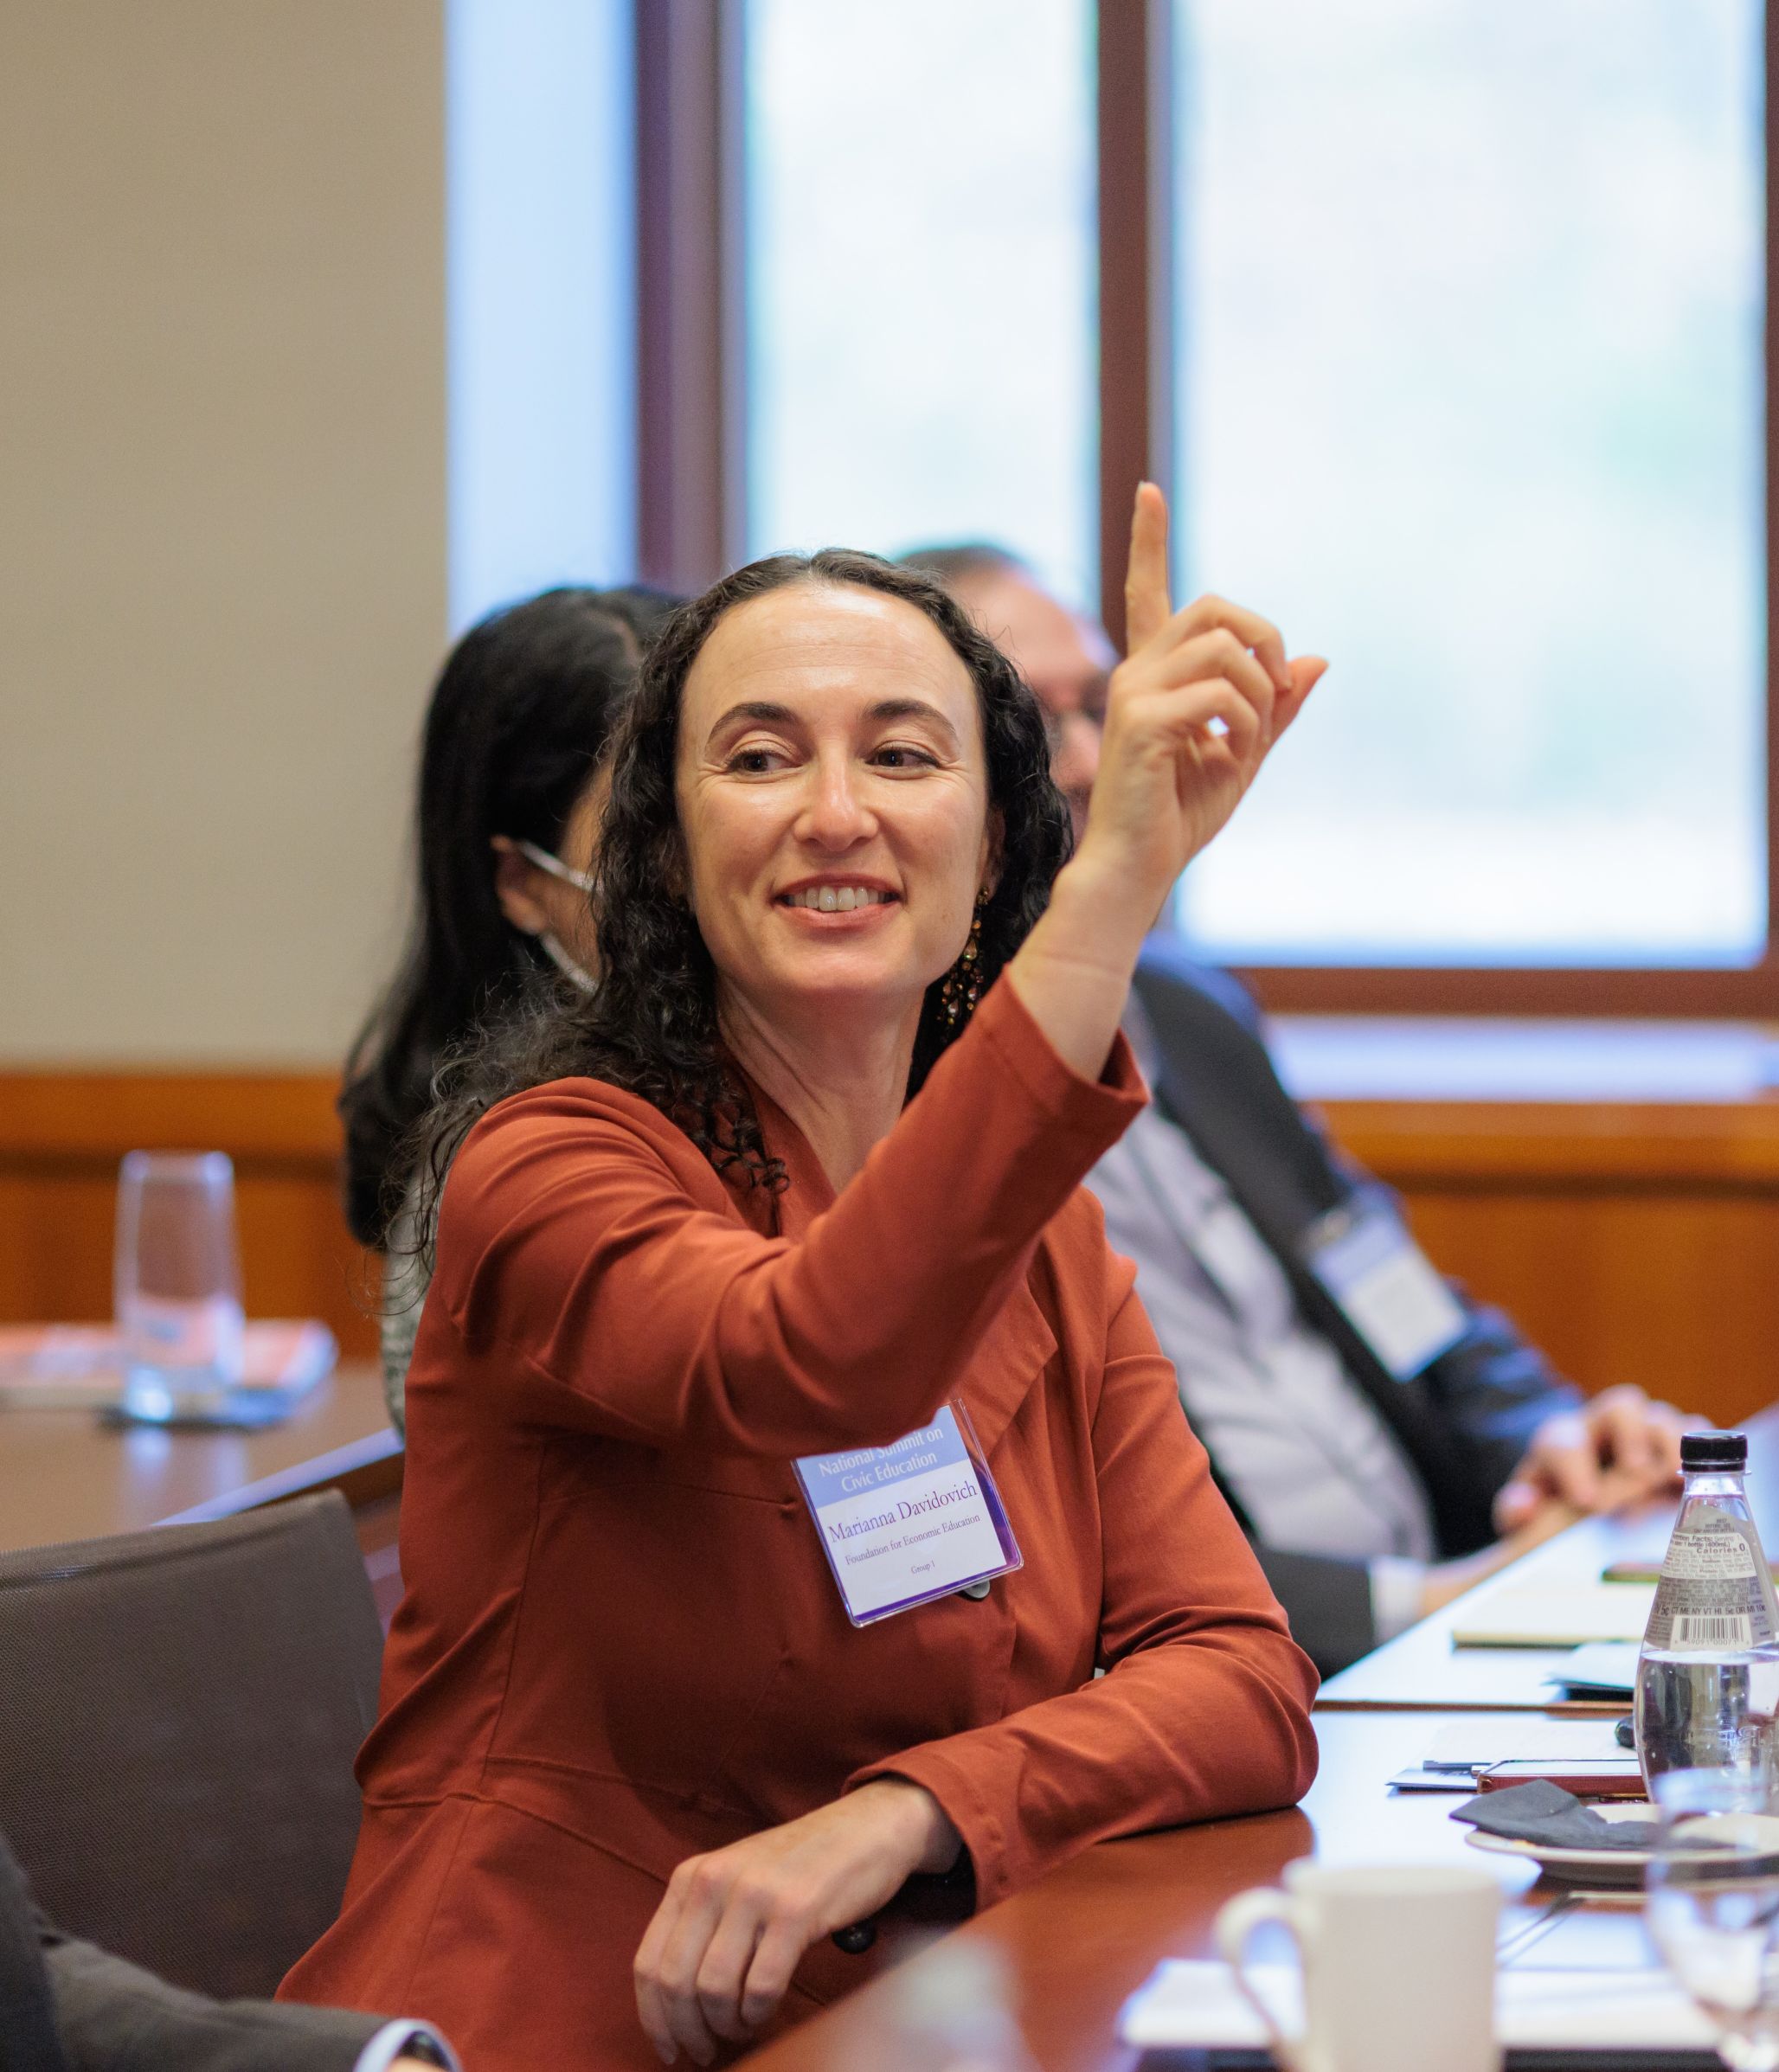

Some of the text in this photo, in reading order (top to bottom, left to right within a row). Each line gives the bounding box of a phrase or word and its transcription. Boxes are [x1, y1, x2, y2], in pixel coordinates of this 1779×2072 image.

[819, 1427, 943, 1478] National Summit on
[841, 1451, 937, 1492] Civic Education
[828, 1480, 978, 1543] Marianna Davidovich
[845, 1514, 980, 1565] Foundation for Economic Education
[1739, 1543, 1746, 1552] 0
[911, 1562, 931, 1575] Group
